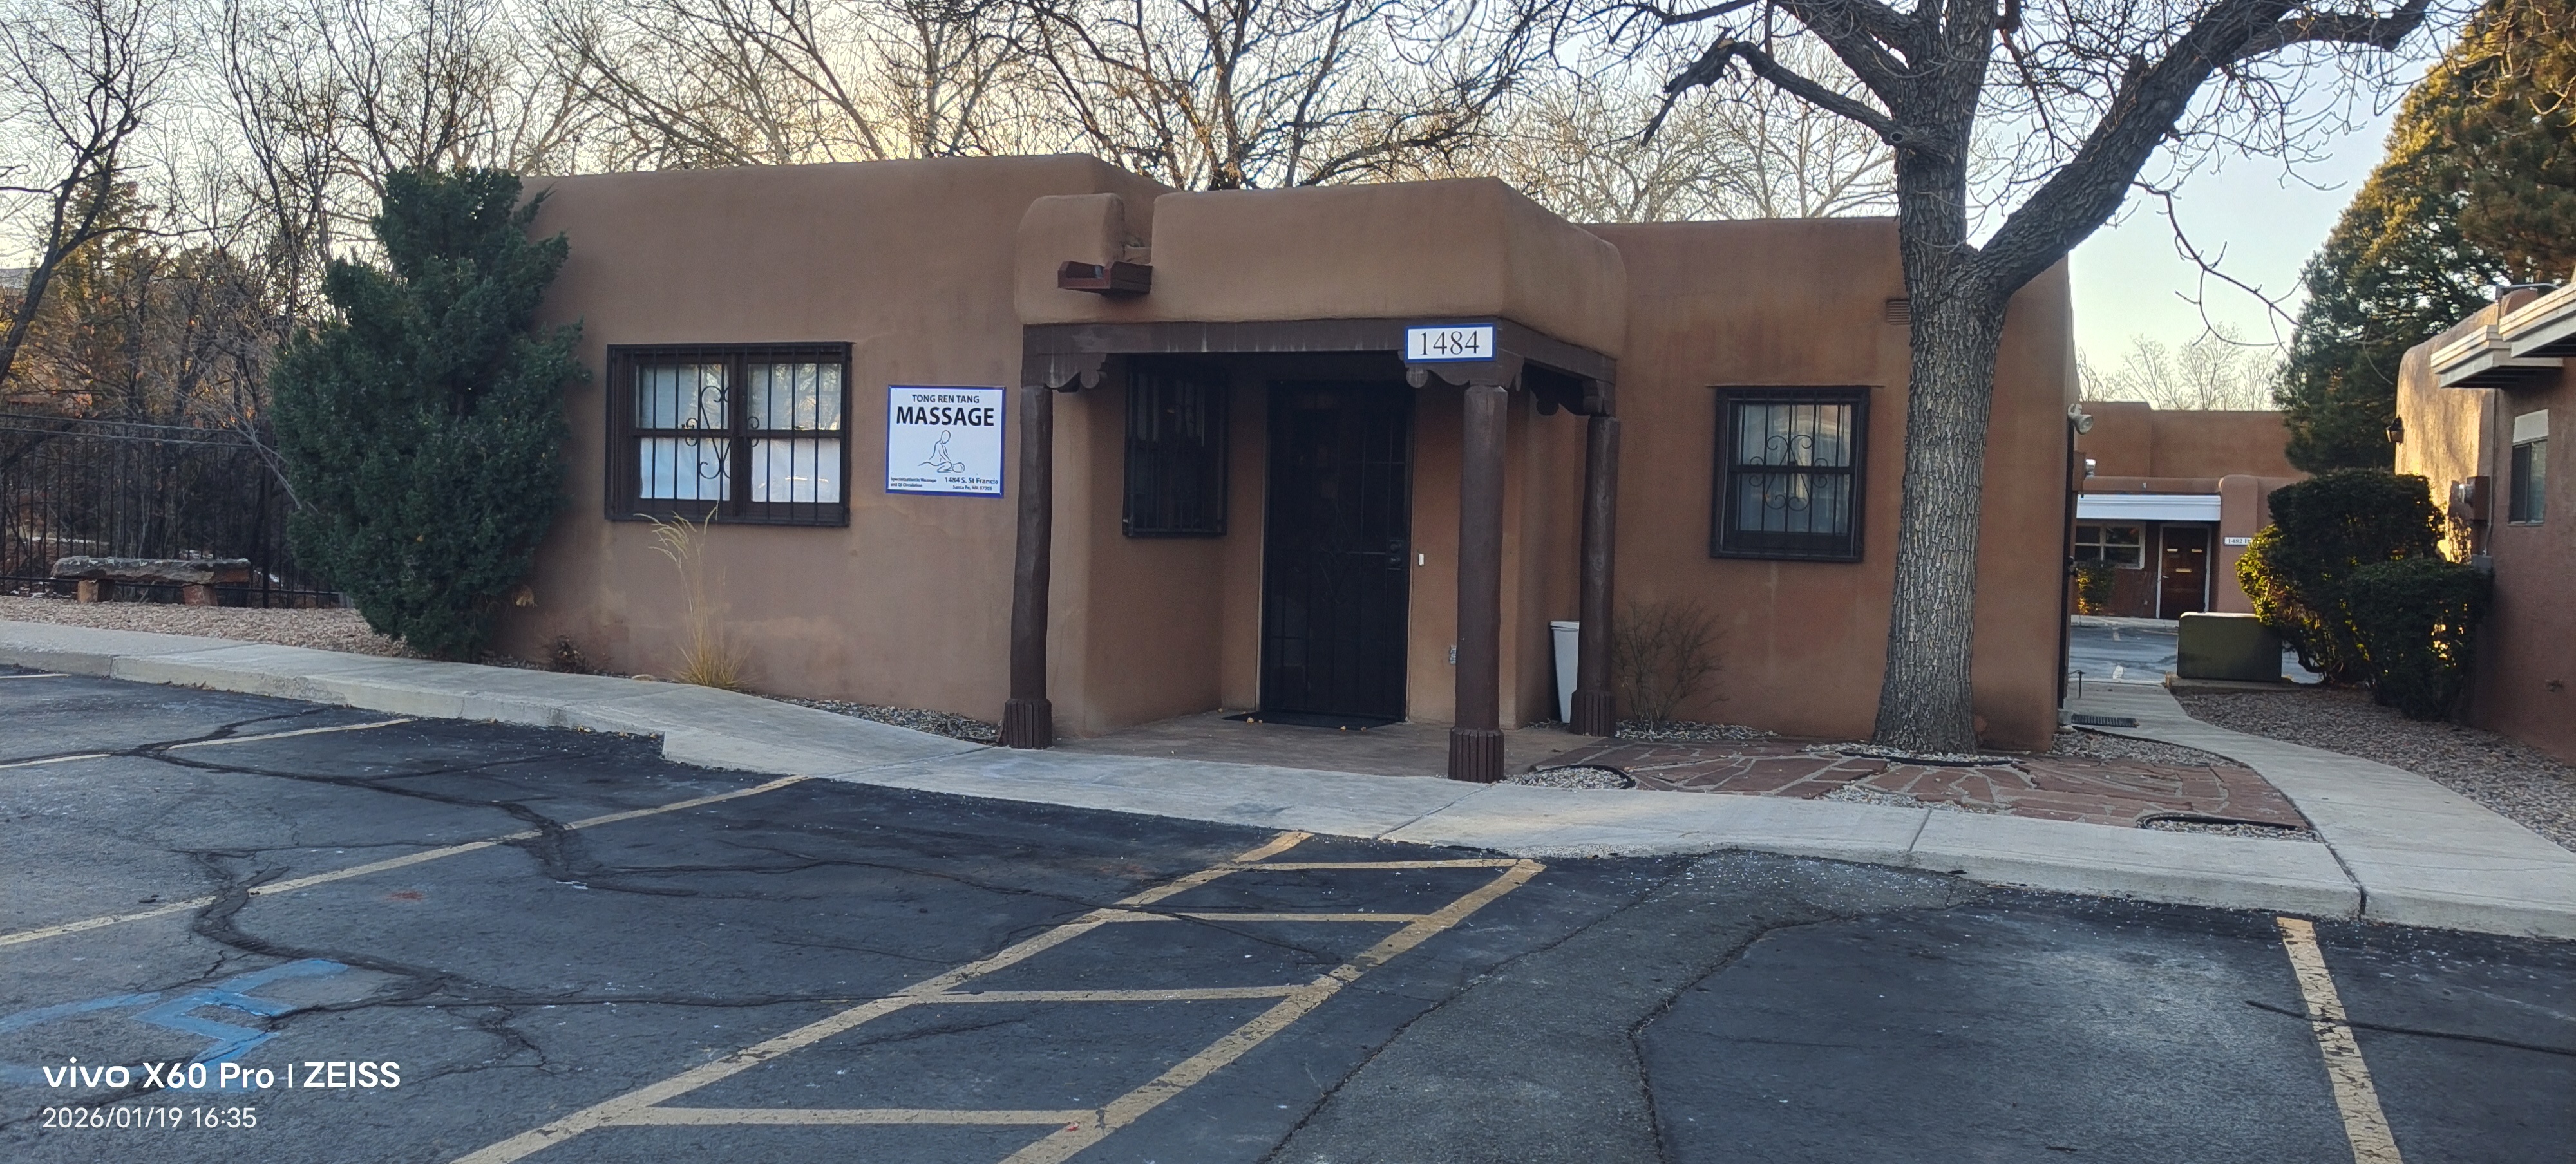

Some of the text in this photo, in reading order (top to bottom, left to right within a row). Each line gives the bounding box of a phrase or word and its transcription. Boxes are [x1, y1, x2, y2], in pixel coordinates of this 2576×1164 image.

[1420, 330, 1481, 355] 1484
[911, 394, 980, 404] TONG REN TANG
[896, 406, 994, 427] MASSAGE
